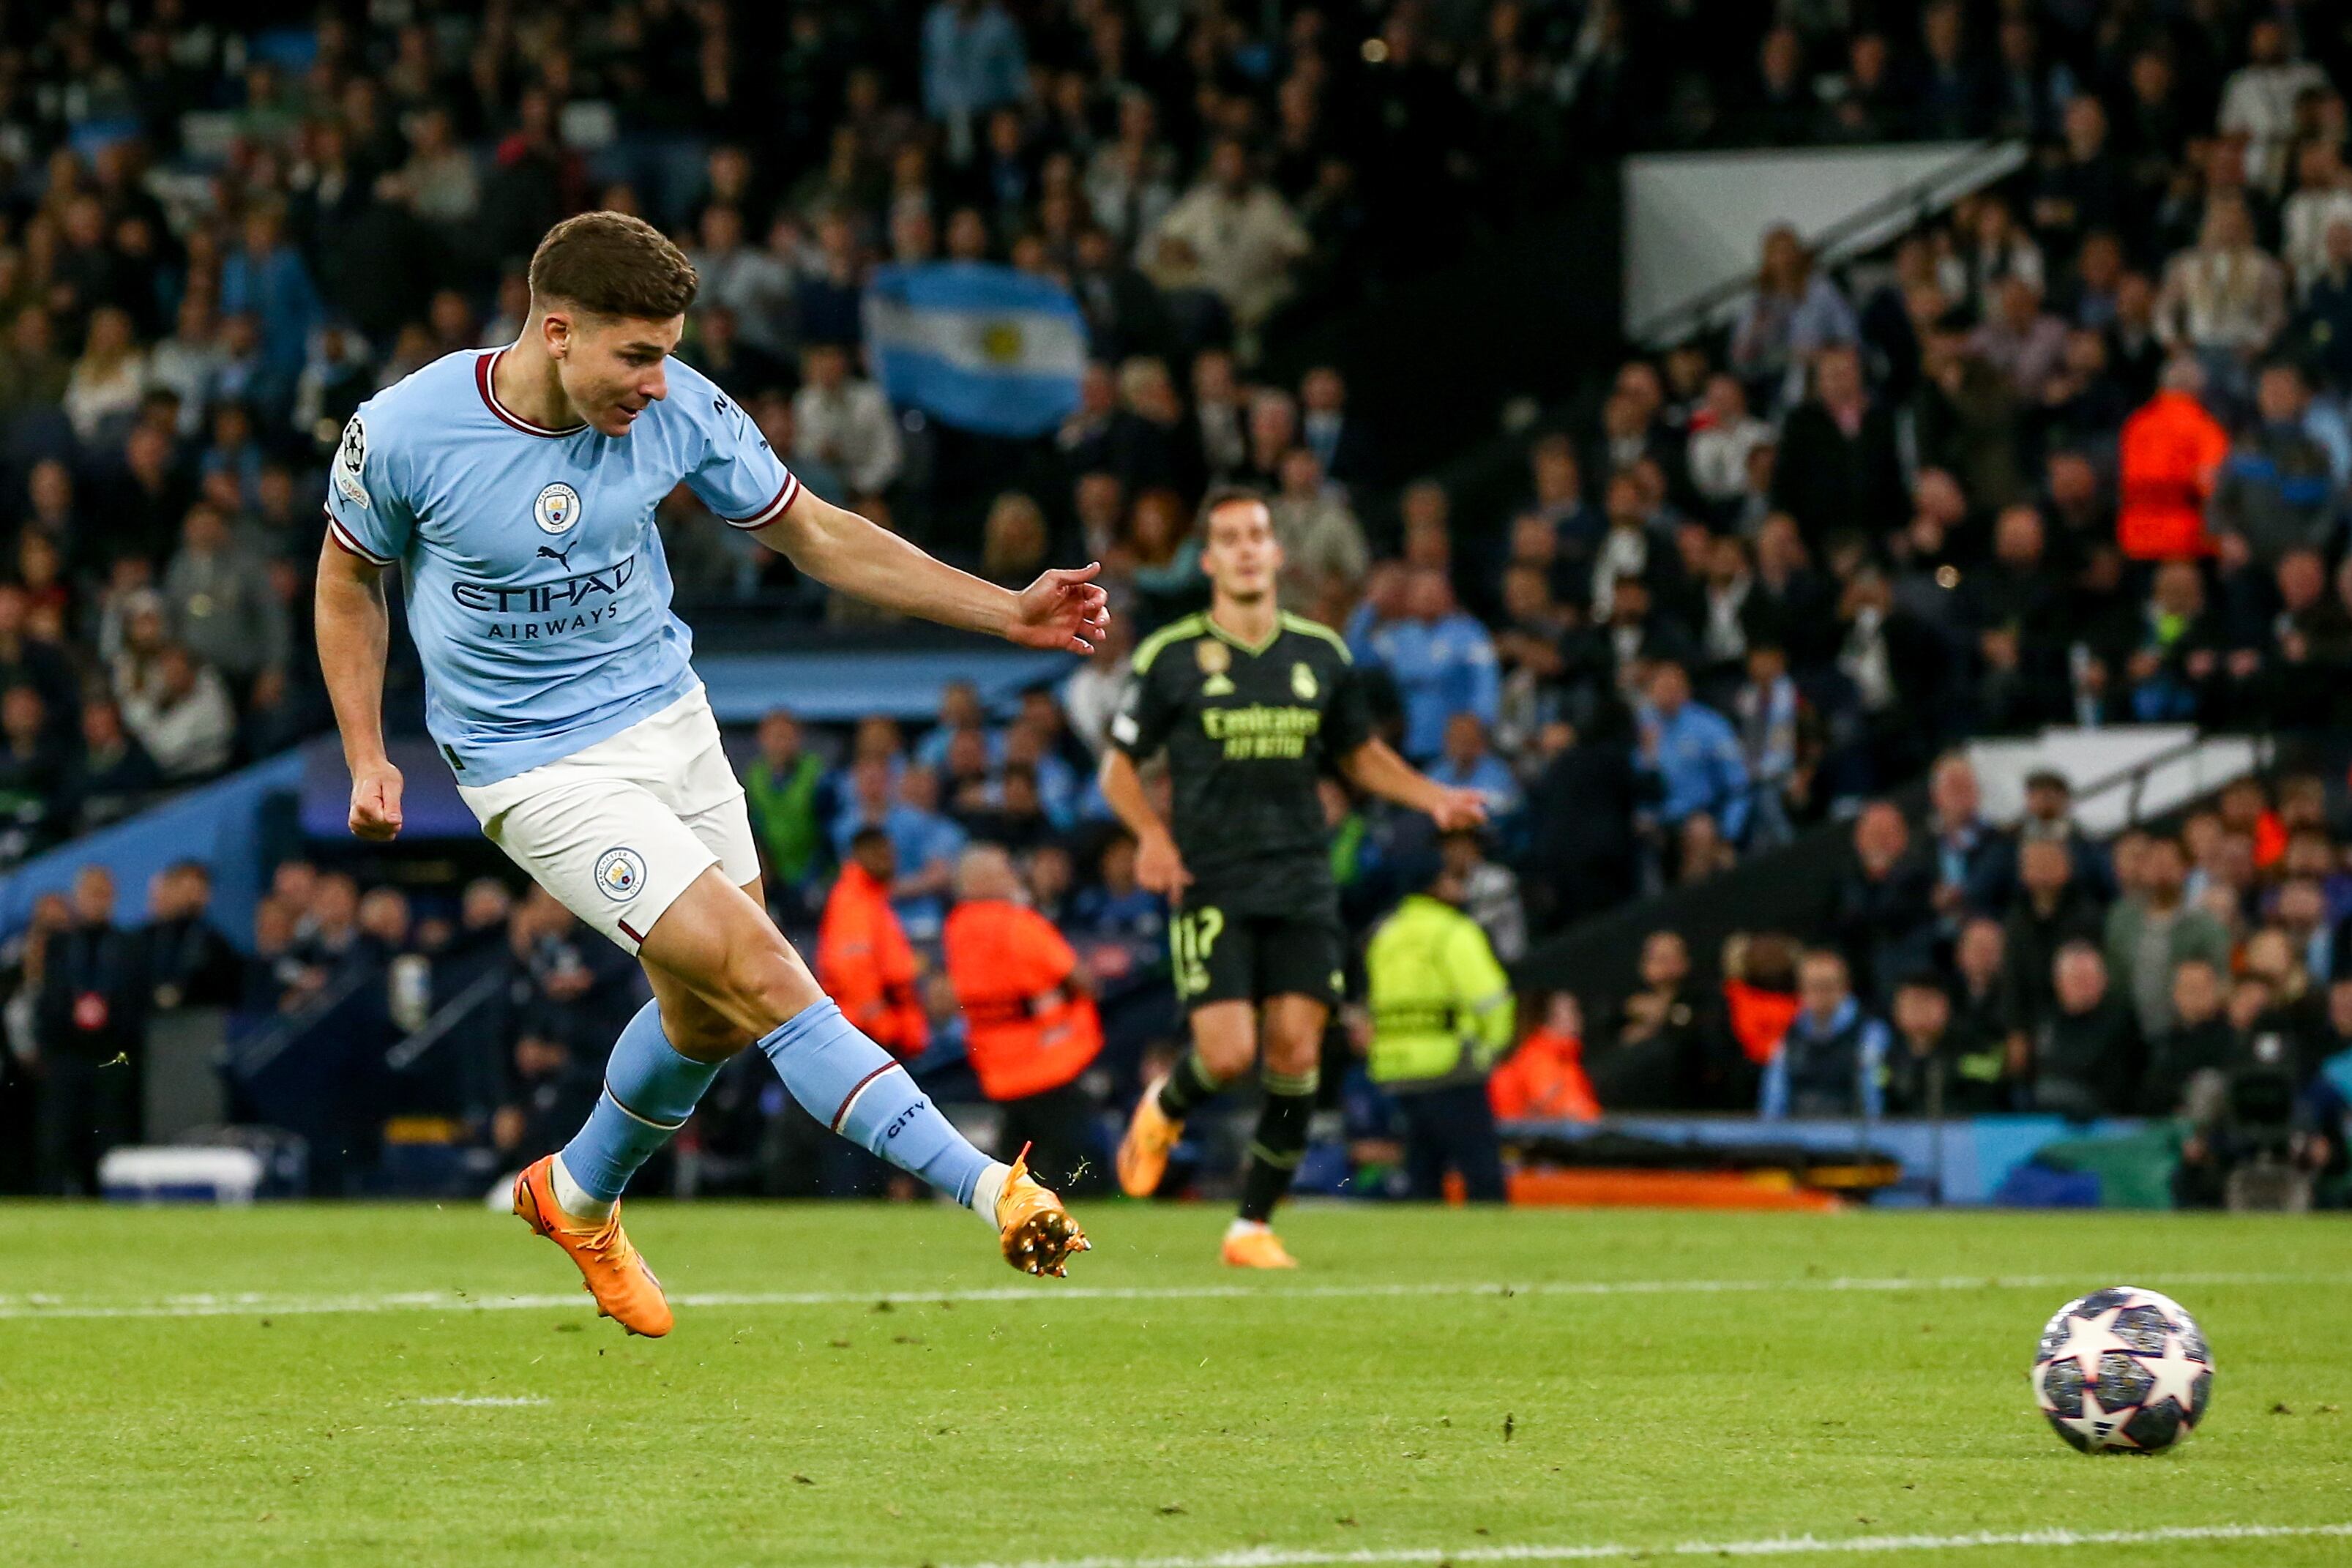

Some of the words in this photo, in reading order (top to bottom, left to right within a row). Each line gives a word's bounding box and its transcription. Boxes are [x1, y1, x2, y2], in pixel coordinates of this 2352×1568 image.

[538, 485, 575, 504] MANCHESTER
[452, 555, 635, 613] ETIHAD
[488, 601, 617, 639] AIRWAYS
[598, 851, 628, 886] MANCHESTER
[630, 881, 641, 895] CITY
[887, 1101, 925, 1139] CITY
